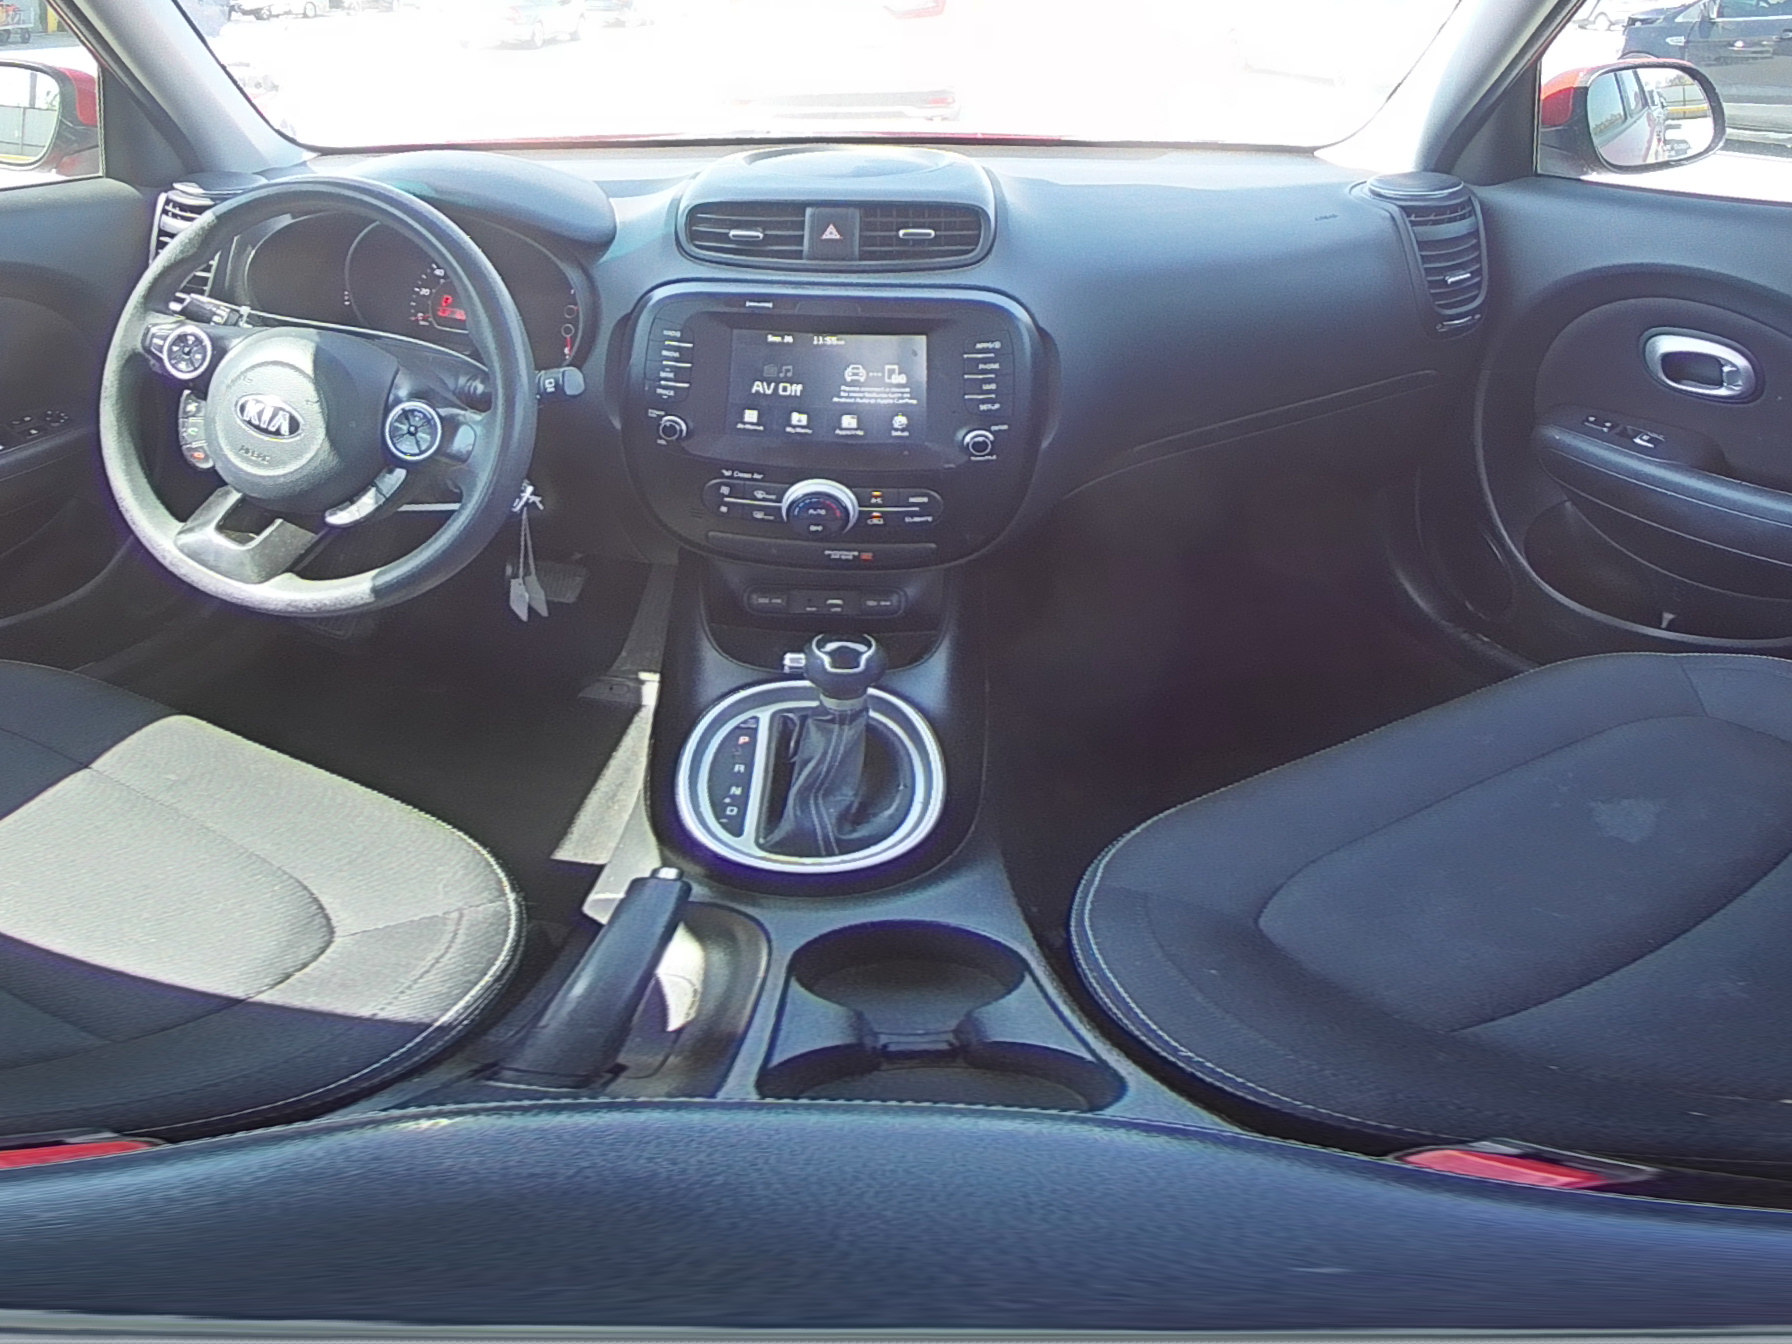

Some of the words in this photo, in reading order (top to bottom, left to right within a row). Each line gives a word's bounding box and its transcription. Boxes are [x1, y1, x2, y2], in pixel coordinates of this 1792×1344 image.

[751, 380, 776, 395] AV
[778, 382, 804, 397] Off
[242, 398, 290, 436] KIA
